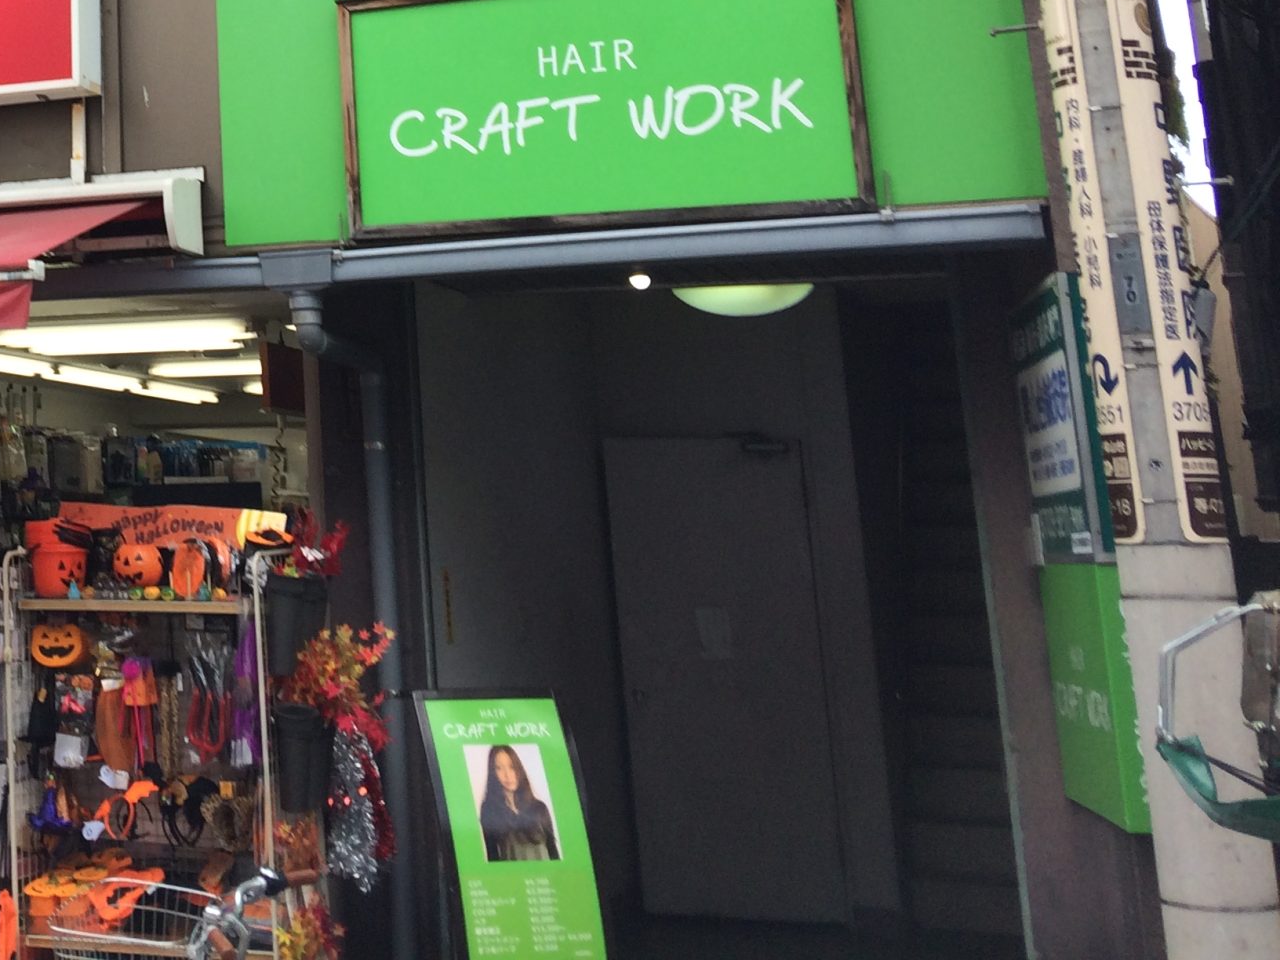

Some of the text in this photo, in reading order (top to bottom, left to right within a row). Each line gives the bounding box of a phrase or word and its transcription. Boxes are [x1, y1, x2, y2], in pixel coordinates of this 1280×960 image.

[537, 39, 638, 79] HAIR
[389, 76, 814, 158] CRAFT WORK
[444, 723, 551, 739] CRAFT WORK
